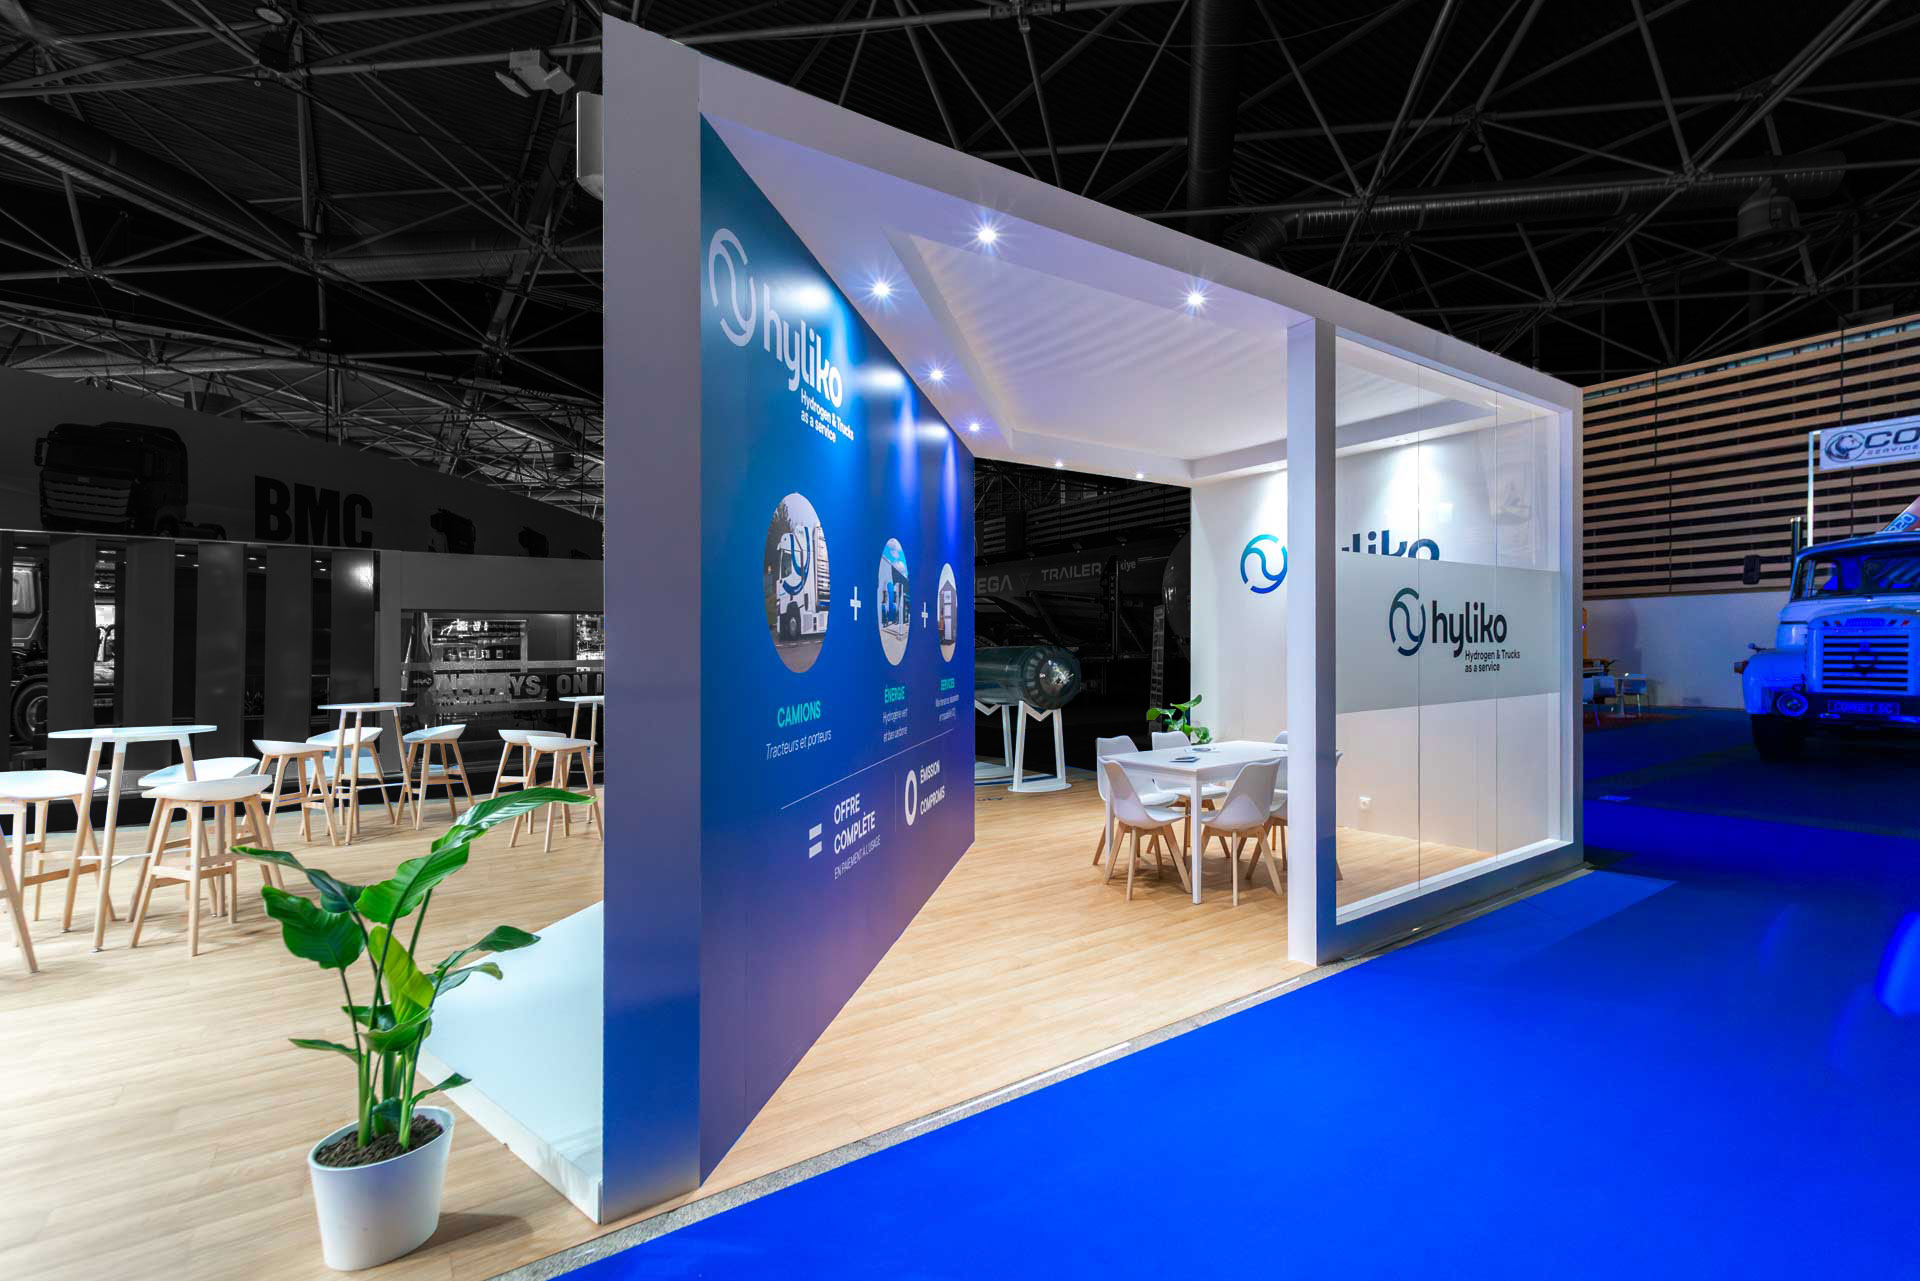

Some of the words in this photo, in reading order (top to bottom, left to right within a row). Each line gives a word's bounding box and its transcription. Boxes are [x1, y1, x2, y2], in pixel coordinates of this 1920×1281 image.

[763, 282, 843, 408] hyliko
[800, 387, 832, 424] Hydrogen
[837, 415, 854, 441] Trucks
[800, 409, 809, 424] as
[809, 415, 815, 428] a
[815, 418, 837, 443] service
[255, 475, 373, 548] BMC
[975, 574, 1013, 594] EGA
[1040, 562, 1102, 581] TRAILER
[1431, 599, 1508, 659] hyliko
[1464, 649, 1496, 662] Hydrogen
[1496, 649, 1501, 660] &
[1501, 648, 1521, 660] Trucks
[1464, 664, 1473, 673] as
[1473, 663, 1478, 673] a
[1478, 660, 1501, 673] service
[556, 674, 589, 695] ON
[777, 700, 821, 728] CAMIONS
[766, 739, 800, 760] Tracteurs
[799, 736, 807, 749] et
[807, 729, 832, 750] porteurs
[920, 759, 941, 784] ÉMISSION
[833, 793, 860, 825] OFFRE
[904, 769, 918, 826] 0
[920, 784, 946, 816] COMPROMIS
[833, 810, 876, 855] COMPLÈTE
